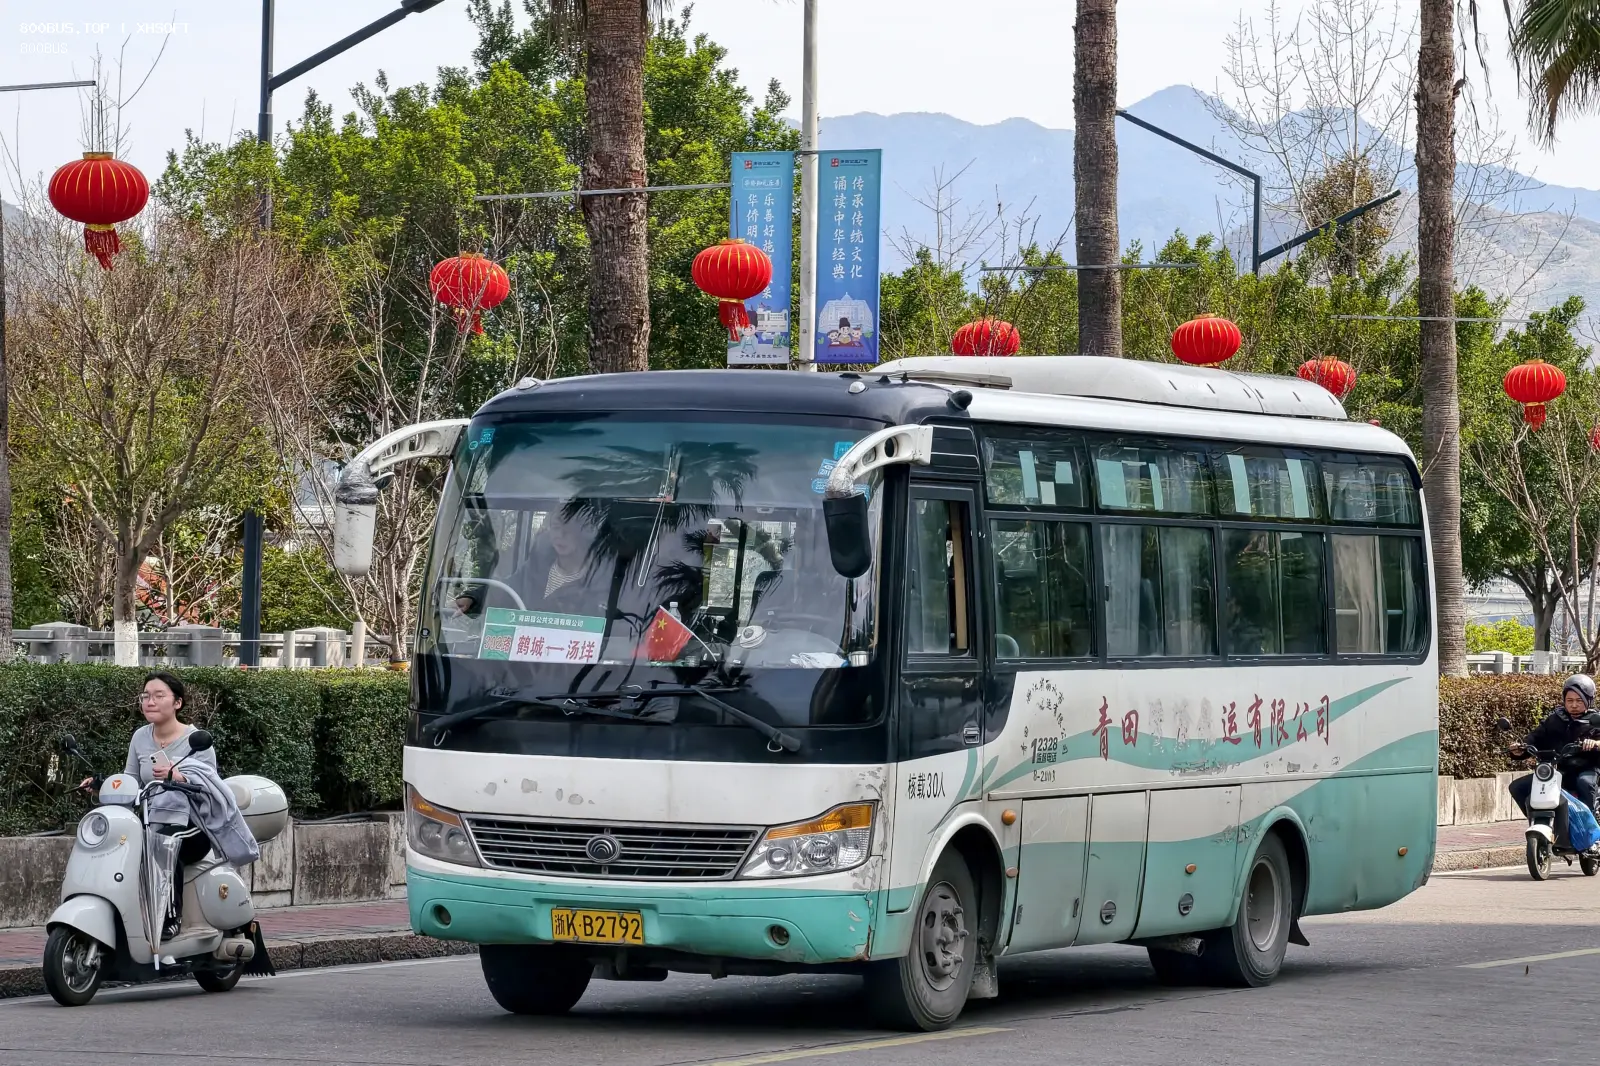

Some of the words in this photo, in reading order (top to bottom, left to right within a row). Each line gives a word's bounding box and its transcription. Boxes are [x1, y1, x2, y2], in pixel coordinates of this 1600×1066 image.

[746, 193, 760, 246] 华侨明
[762, 192, 775, 299] 乐善好施采
[831, 176, 848, 280] 诵读中华经典
[849, 176, 865, 279] 传承传统文化
[516, 635, 545, 656] 鹤城
[566, 639, 596, 662] 汤垟
[1031, 737, 1058, 764] 12328
[1092, 695, 1139, 761] 青田
[1221, 693, 1330, 750] 运有限公司
[908, 772, 946, 800] 核载30人
